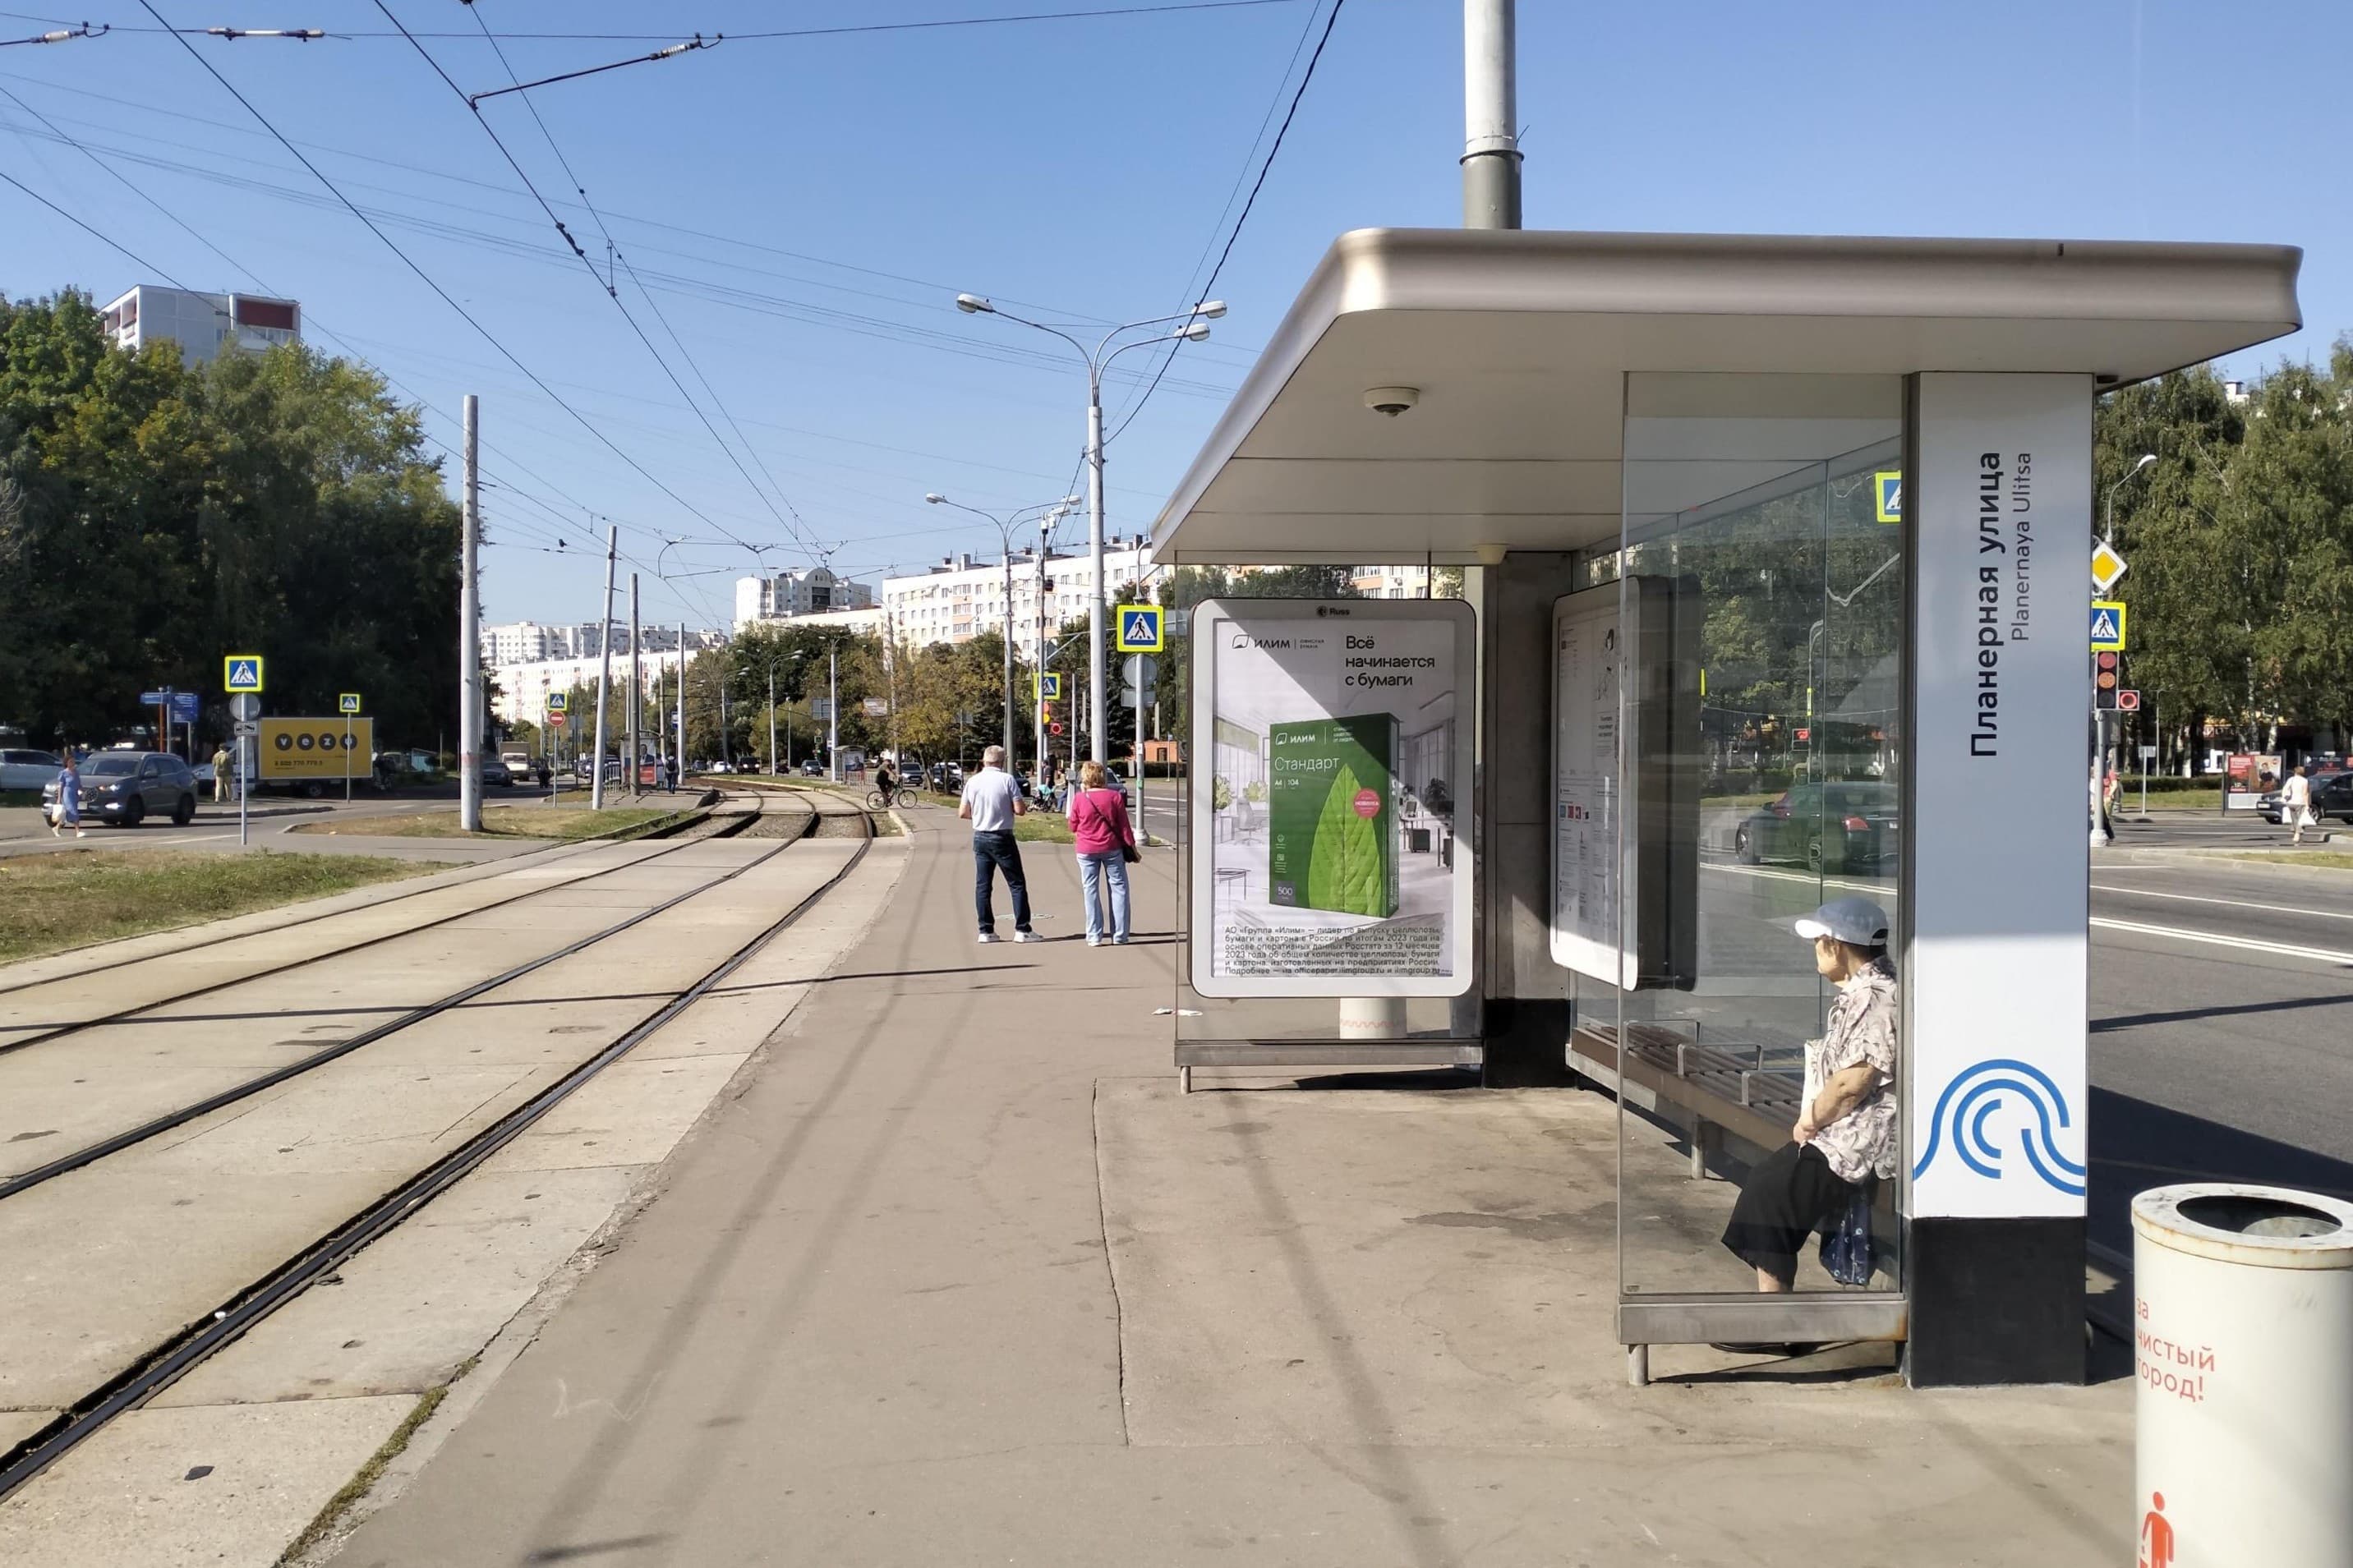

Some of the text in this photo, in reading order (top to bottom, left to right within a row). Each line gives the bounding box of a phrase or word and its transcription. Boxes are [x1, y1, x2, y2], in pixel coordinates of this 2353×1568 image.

[2011, 453, 2034, 641] Planernaya Ulitsa
[1329, 607, 1350, 616] Russ
[1971, 453, 2005, 757] Планерная улица
[1346, 635, 1375, 650] Всё
[1346, 657, 1435, 668] начинается
[1345, 673, 1413, 689] с бумаги
[1274, 756, 1341, 773] Стандарт
[1278, 887, 1293, 895] 500
[2136, 1298, 2149, 1321] за
